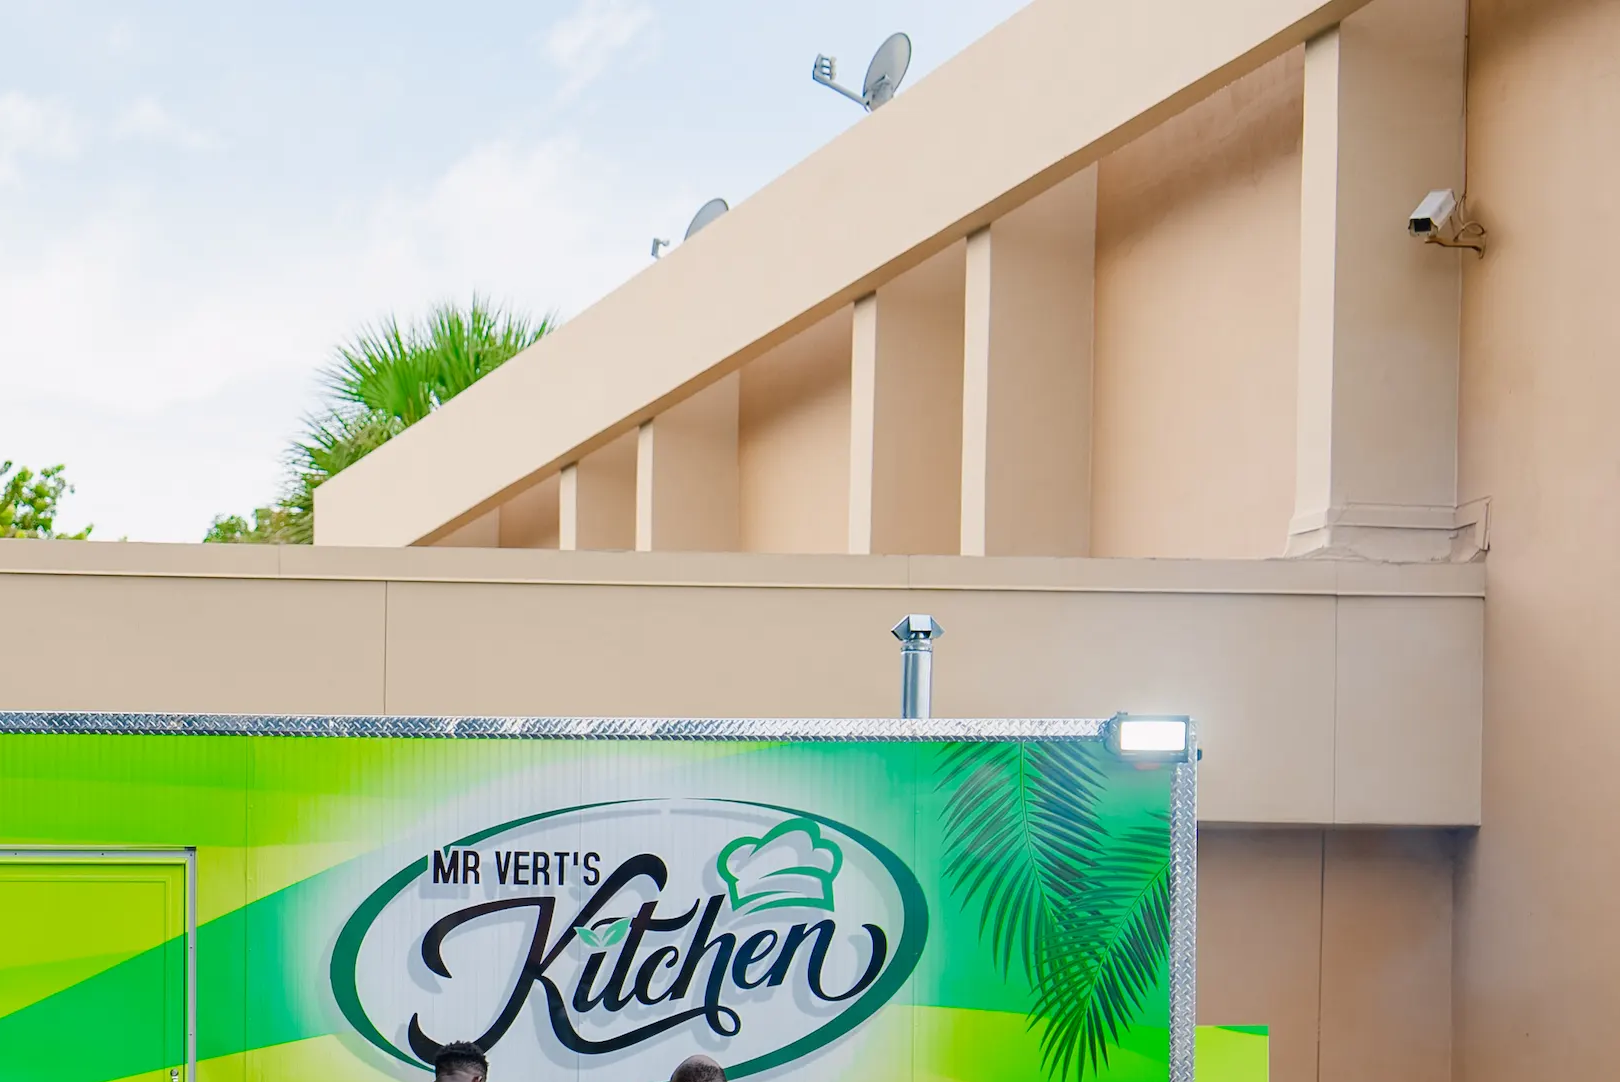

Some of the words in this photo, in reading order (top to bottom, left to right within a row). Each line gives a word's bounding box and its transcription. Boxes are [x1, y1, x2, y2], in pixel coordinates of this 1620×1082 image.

[432, 849, 481, 885] MR
[494, 851, 602, 887] VERT'S
[407, 853, 888, 1065] Kitchen
